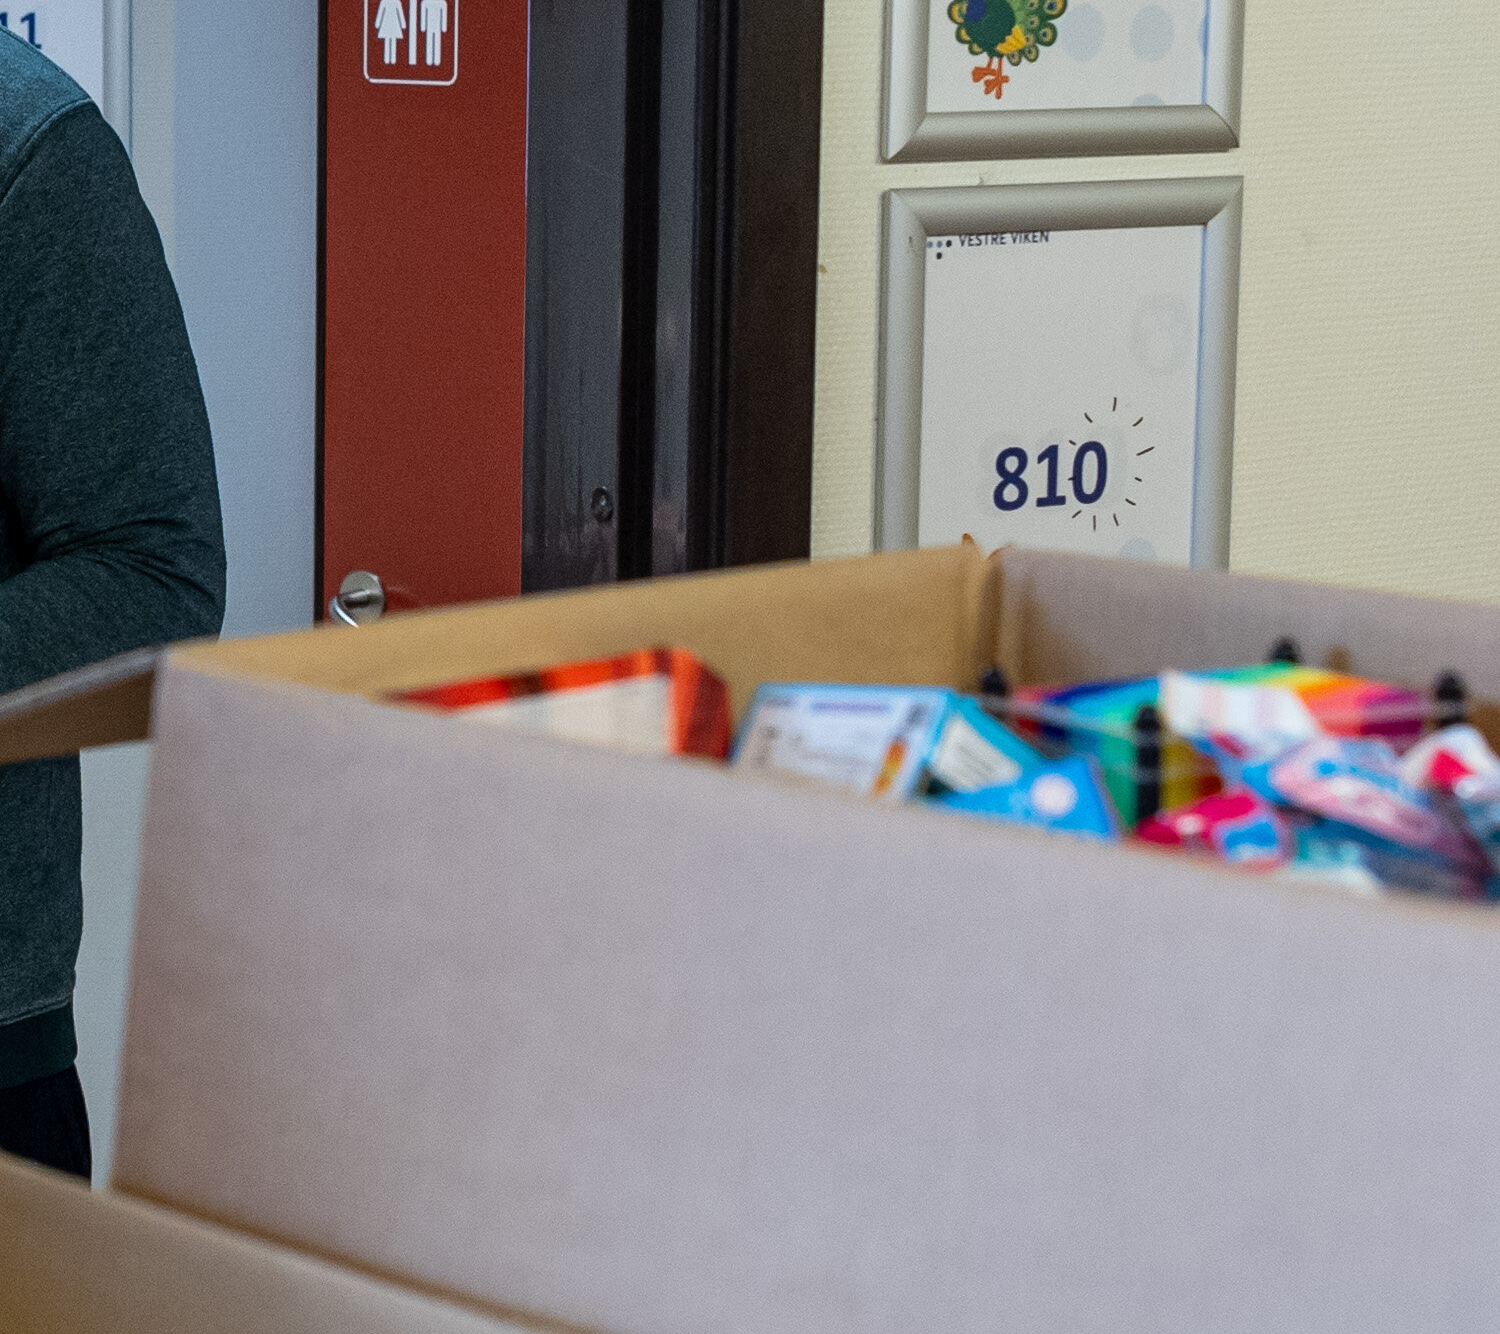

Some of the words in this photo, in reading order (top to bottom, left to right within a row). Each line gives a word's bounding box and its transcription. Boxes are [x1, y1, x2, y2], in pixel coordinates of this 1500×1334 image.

[958, 234, 1008, 247] VESTRE
[1011, 231, 1050, 244] VIKEN
[992, 439, 1109, 512] 810
